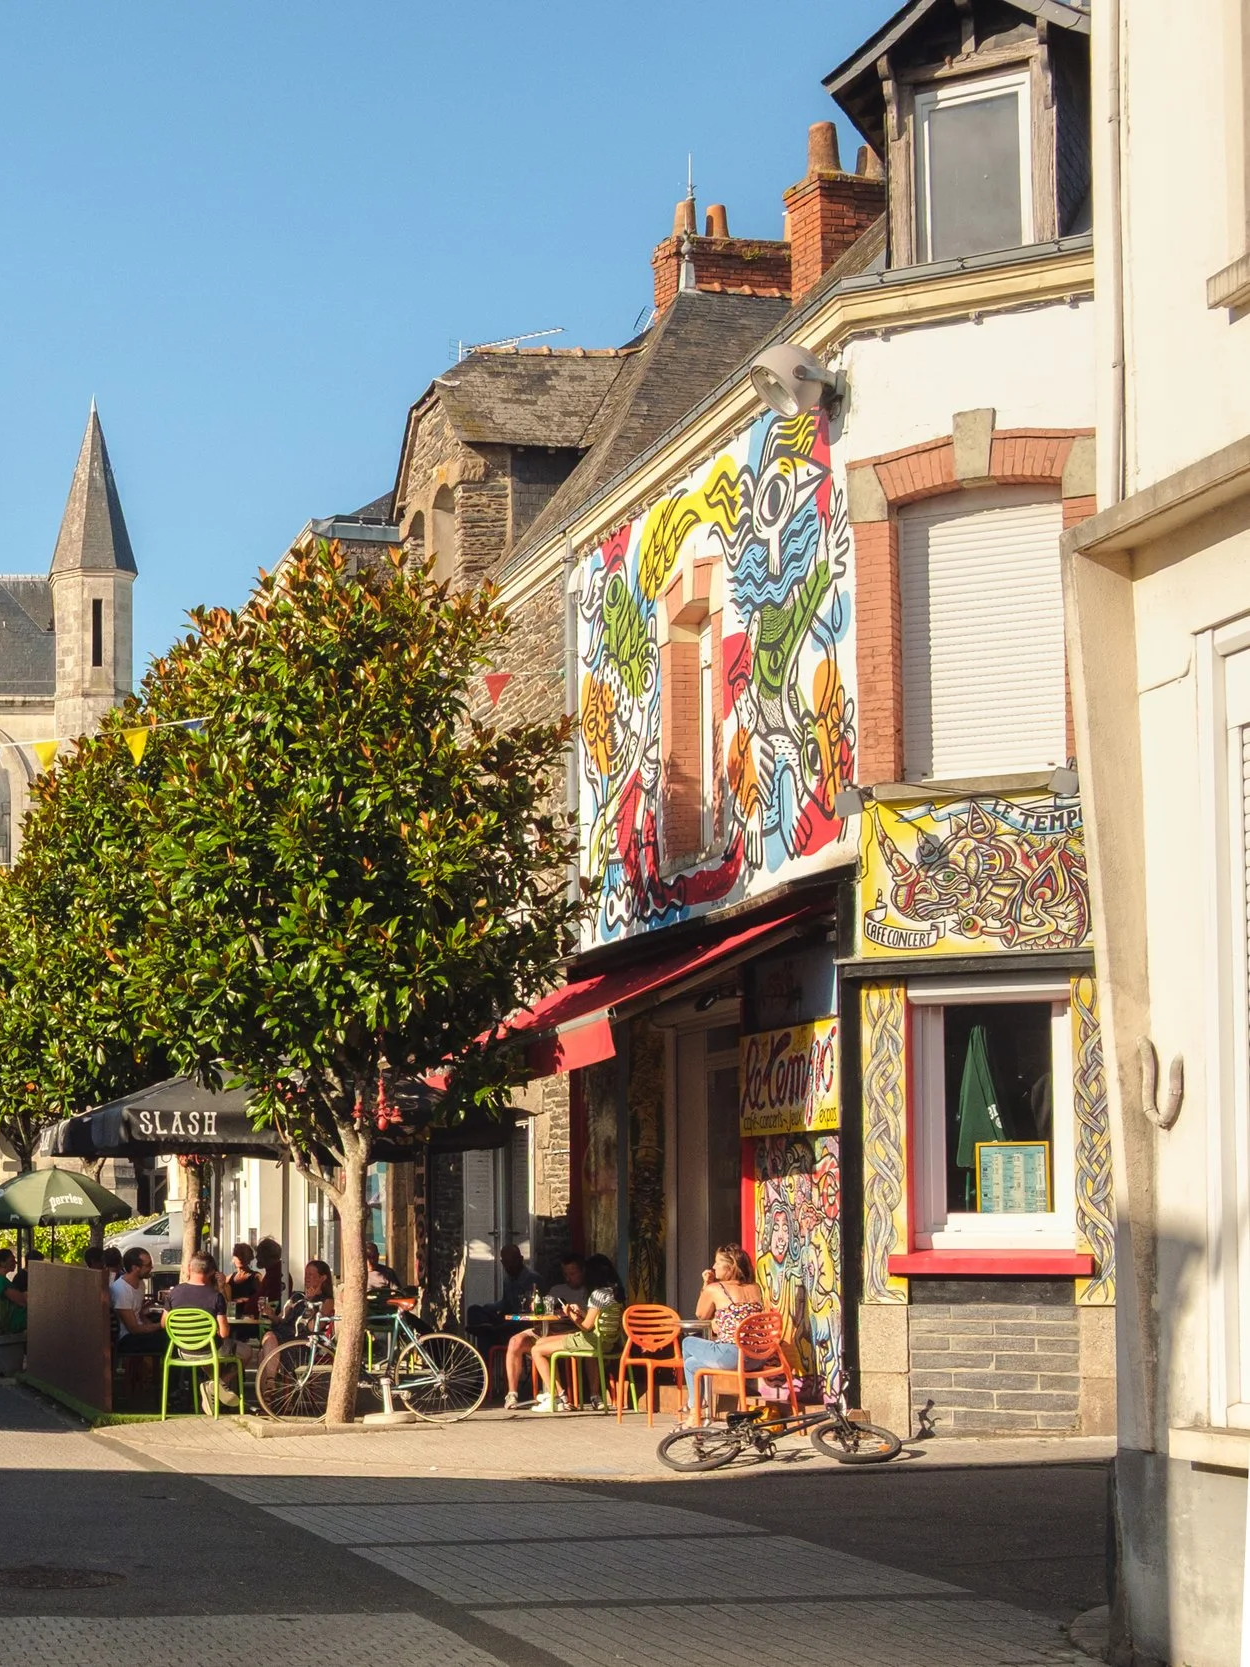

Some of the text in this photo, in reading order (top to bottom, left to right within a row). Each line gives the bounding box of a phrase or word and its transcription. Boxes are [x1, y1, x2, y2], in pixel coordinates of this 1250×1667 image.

[990, 799, 1083, 832] LE TEMP
[866, 922, 933, 947] CAFE CONCERT
[139, 1110, 217, 1136] SLASH
[819, 1107, 837, 1127] expos
